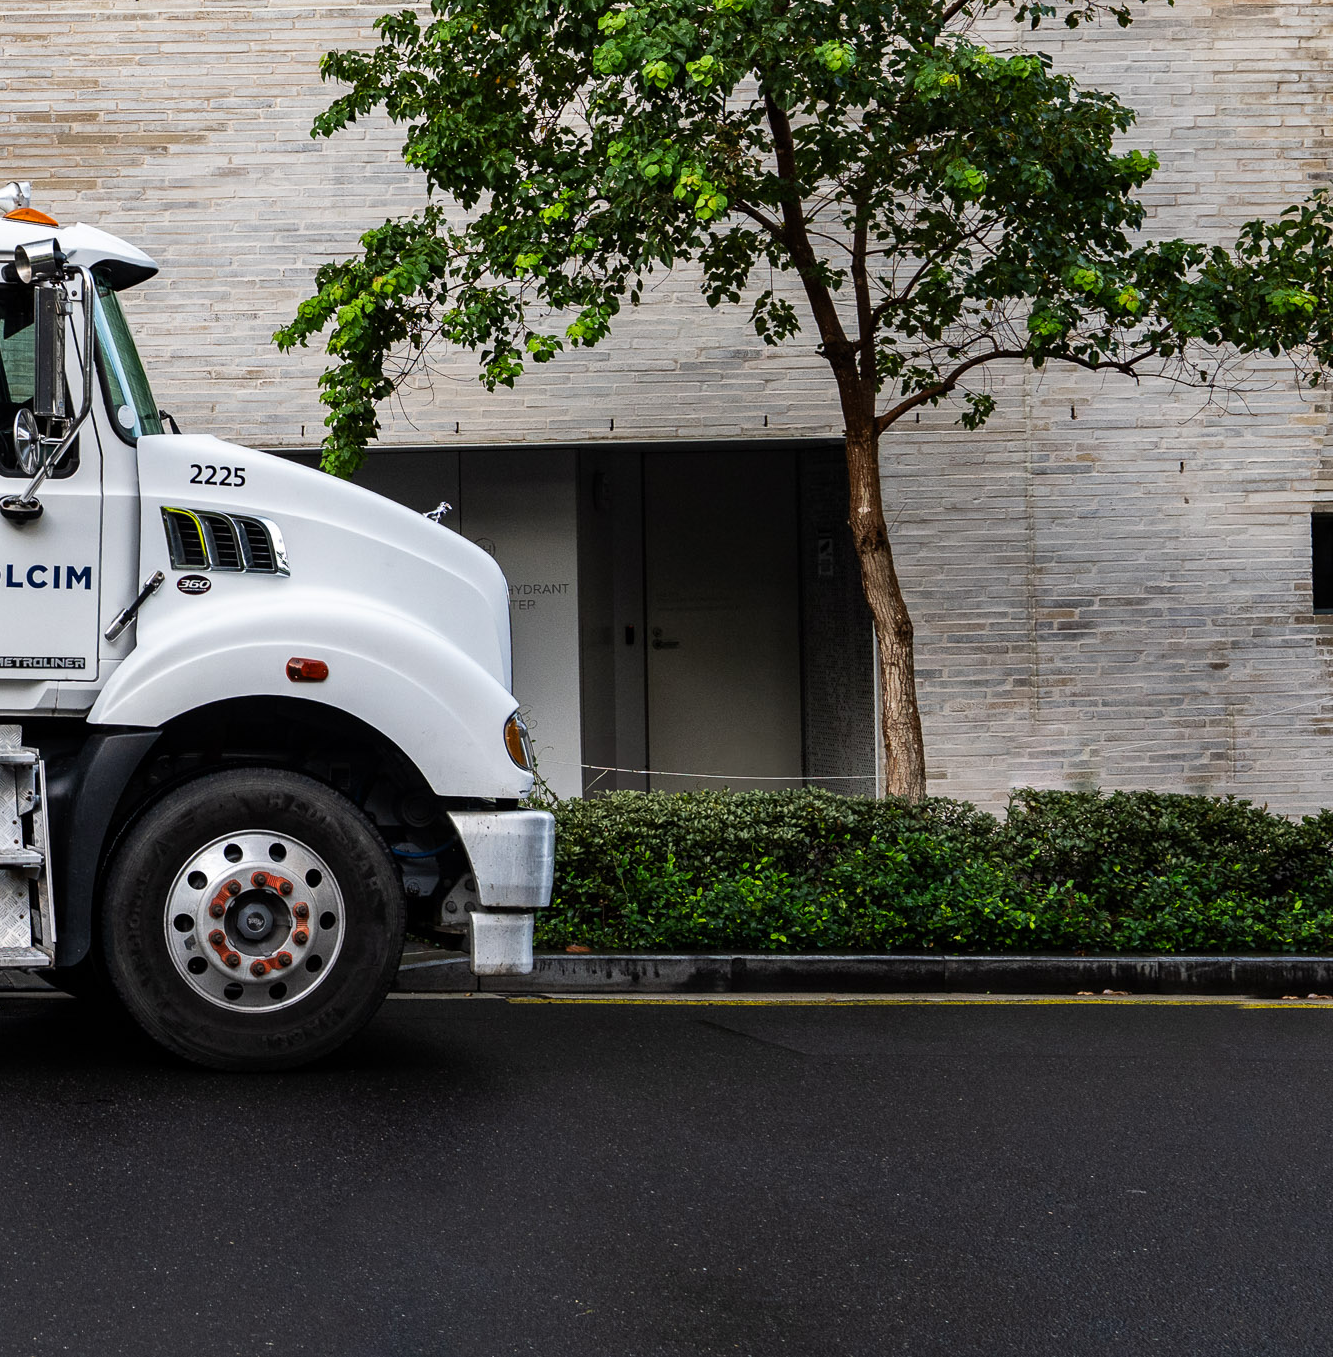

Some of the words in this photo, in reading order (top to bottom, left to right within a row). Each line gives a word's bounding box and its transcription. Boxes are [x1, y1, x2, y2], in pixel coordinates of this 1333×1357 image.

[189, 464, 246, 487] 2225
[178, 579, 211, 589] 360
[510, 599, 536, 610] TER
